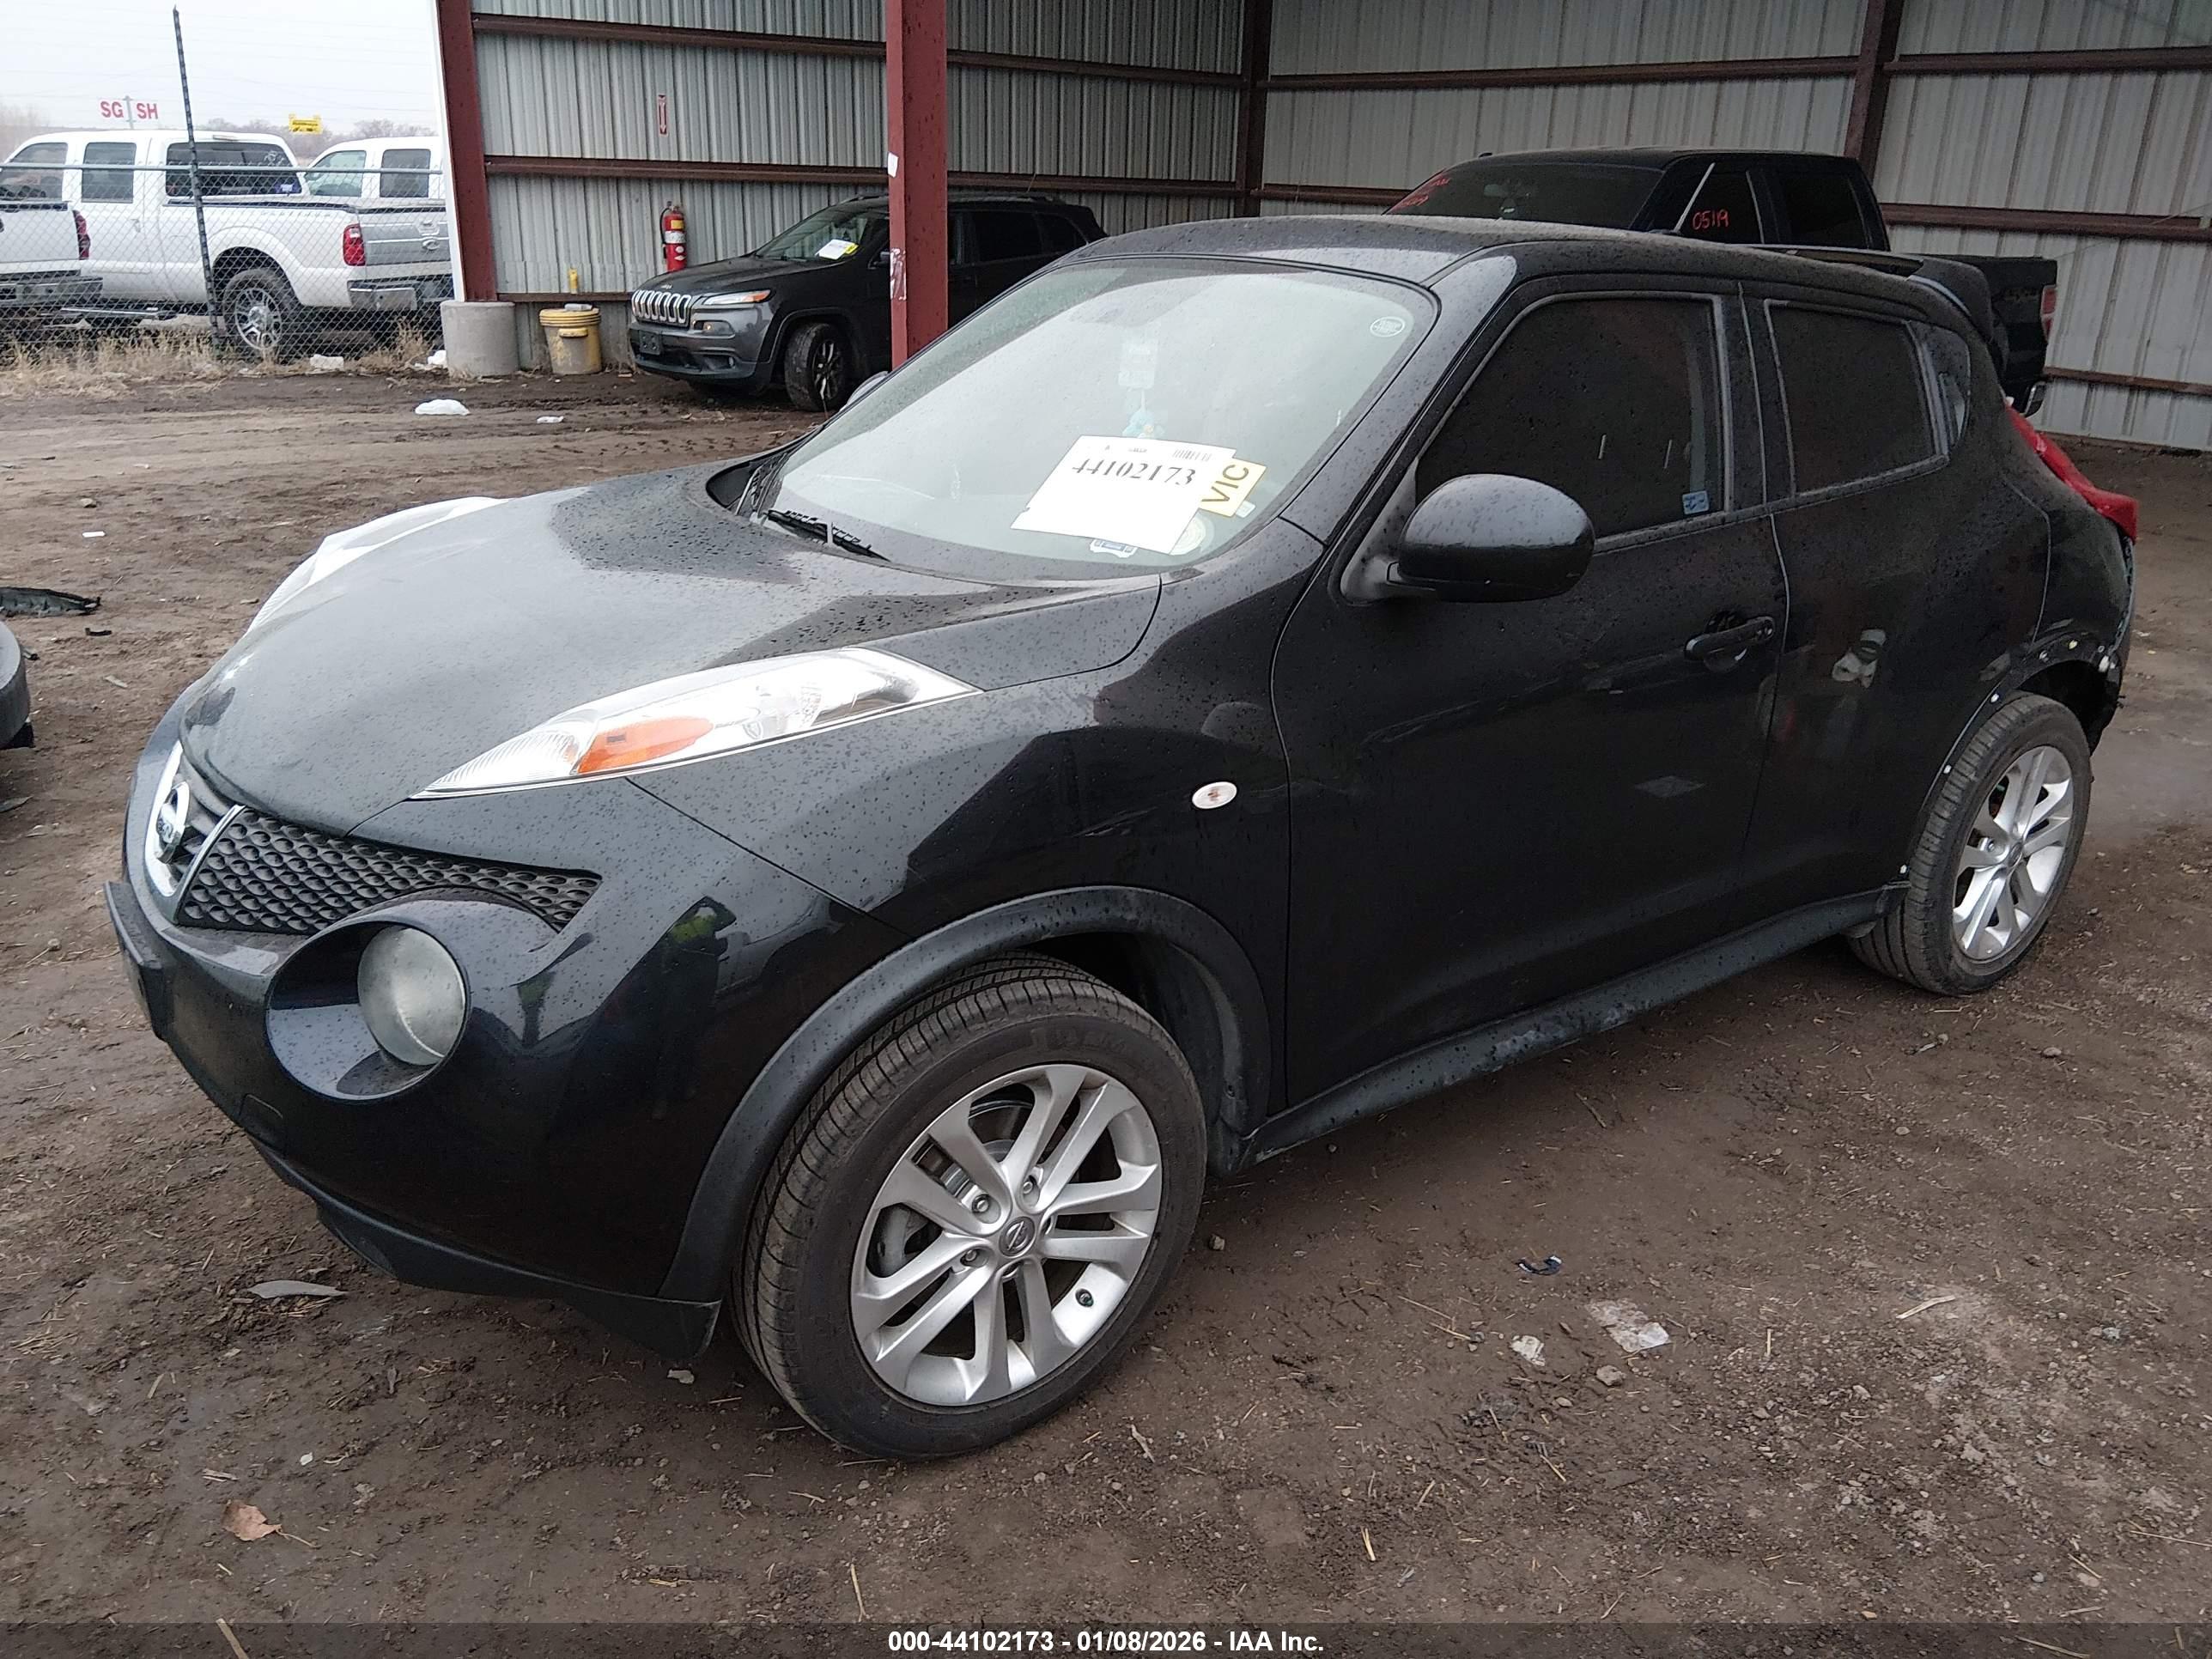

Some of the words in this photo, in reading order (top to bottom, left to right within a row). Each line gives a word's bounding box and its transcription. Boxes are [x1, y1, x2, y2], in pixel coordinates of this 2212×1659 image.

[100, 100, 125, 118] SG
[136, 102, 159, 120] SH
[1072, 458, 1196, 486] 44102173
[1200, 463, 1250, 502] VIC
